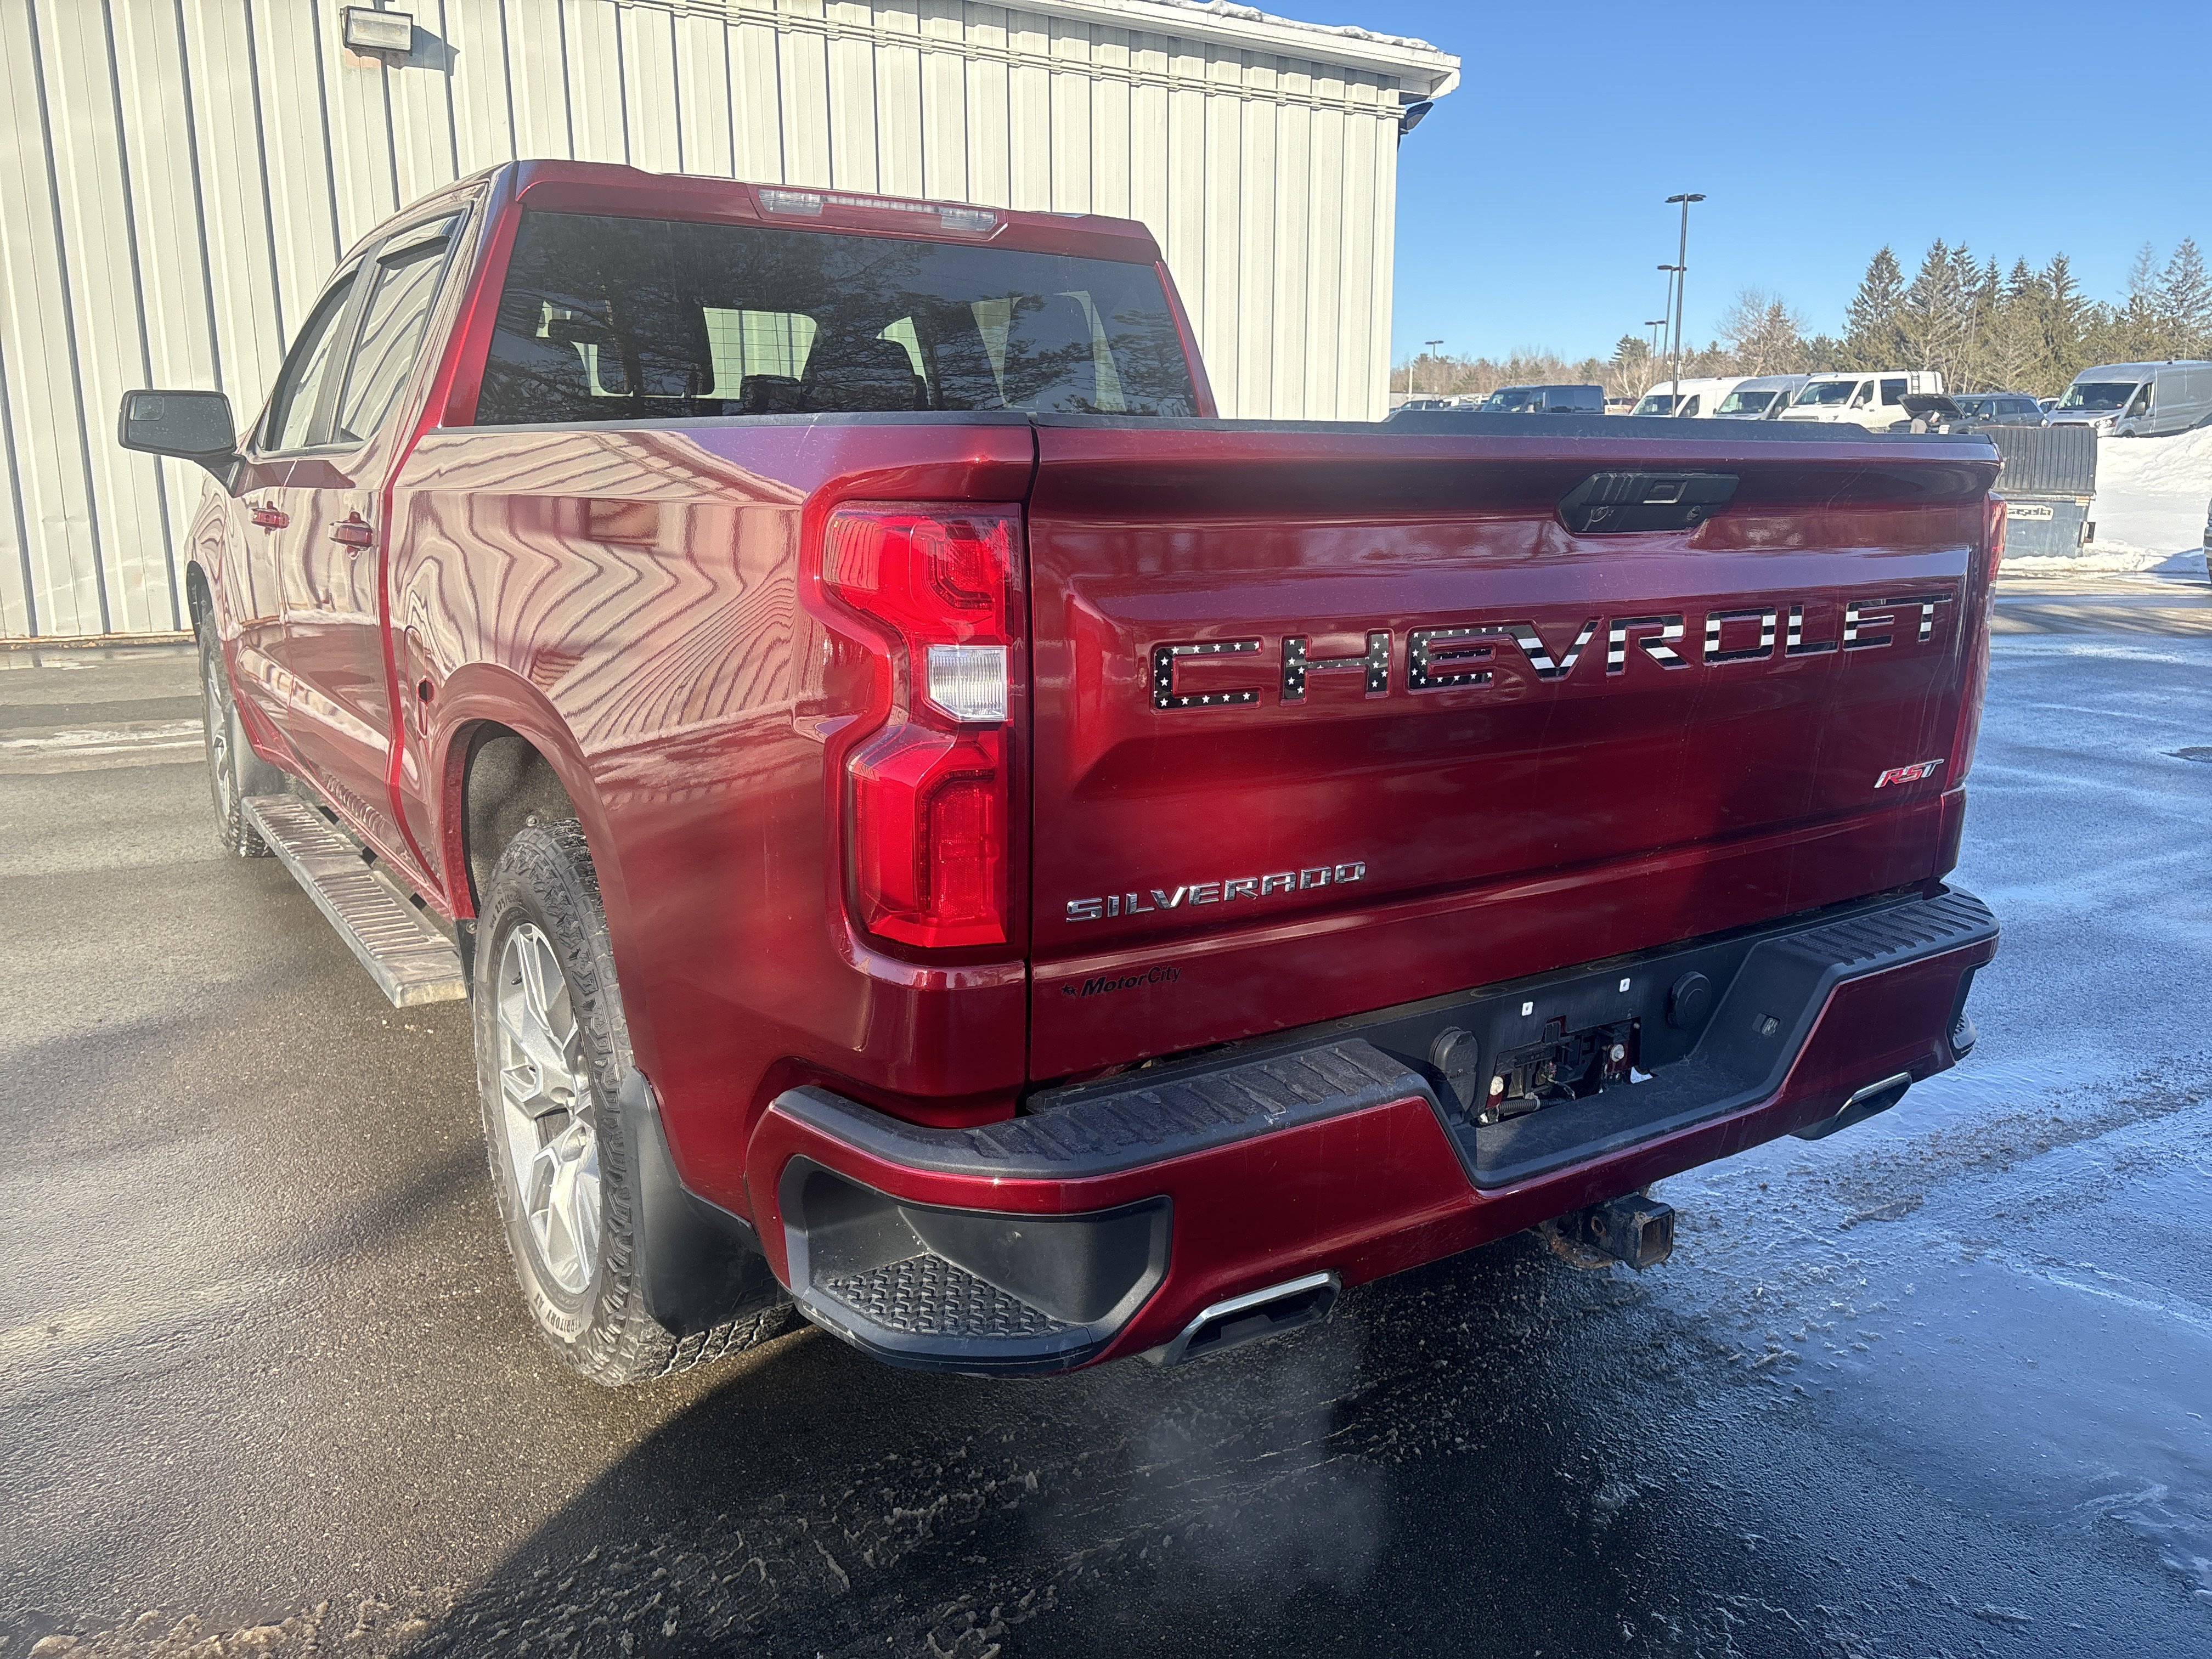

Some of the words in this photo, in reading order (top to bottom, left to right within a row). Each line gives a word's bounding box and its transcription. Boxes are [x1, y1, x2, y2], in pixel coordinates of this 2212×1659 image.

[1151, 592, 1952, 713] CHEVROLET
[1874, 758, 1945, 788] RST
[1066, 861, 1366, 922] SILVERADO
[1081, 966, 1182, 997] MotorCity
